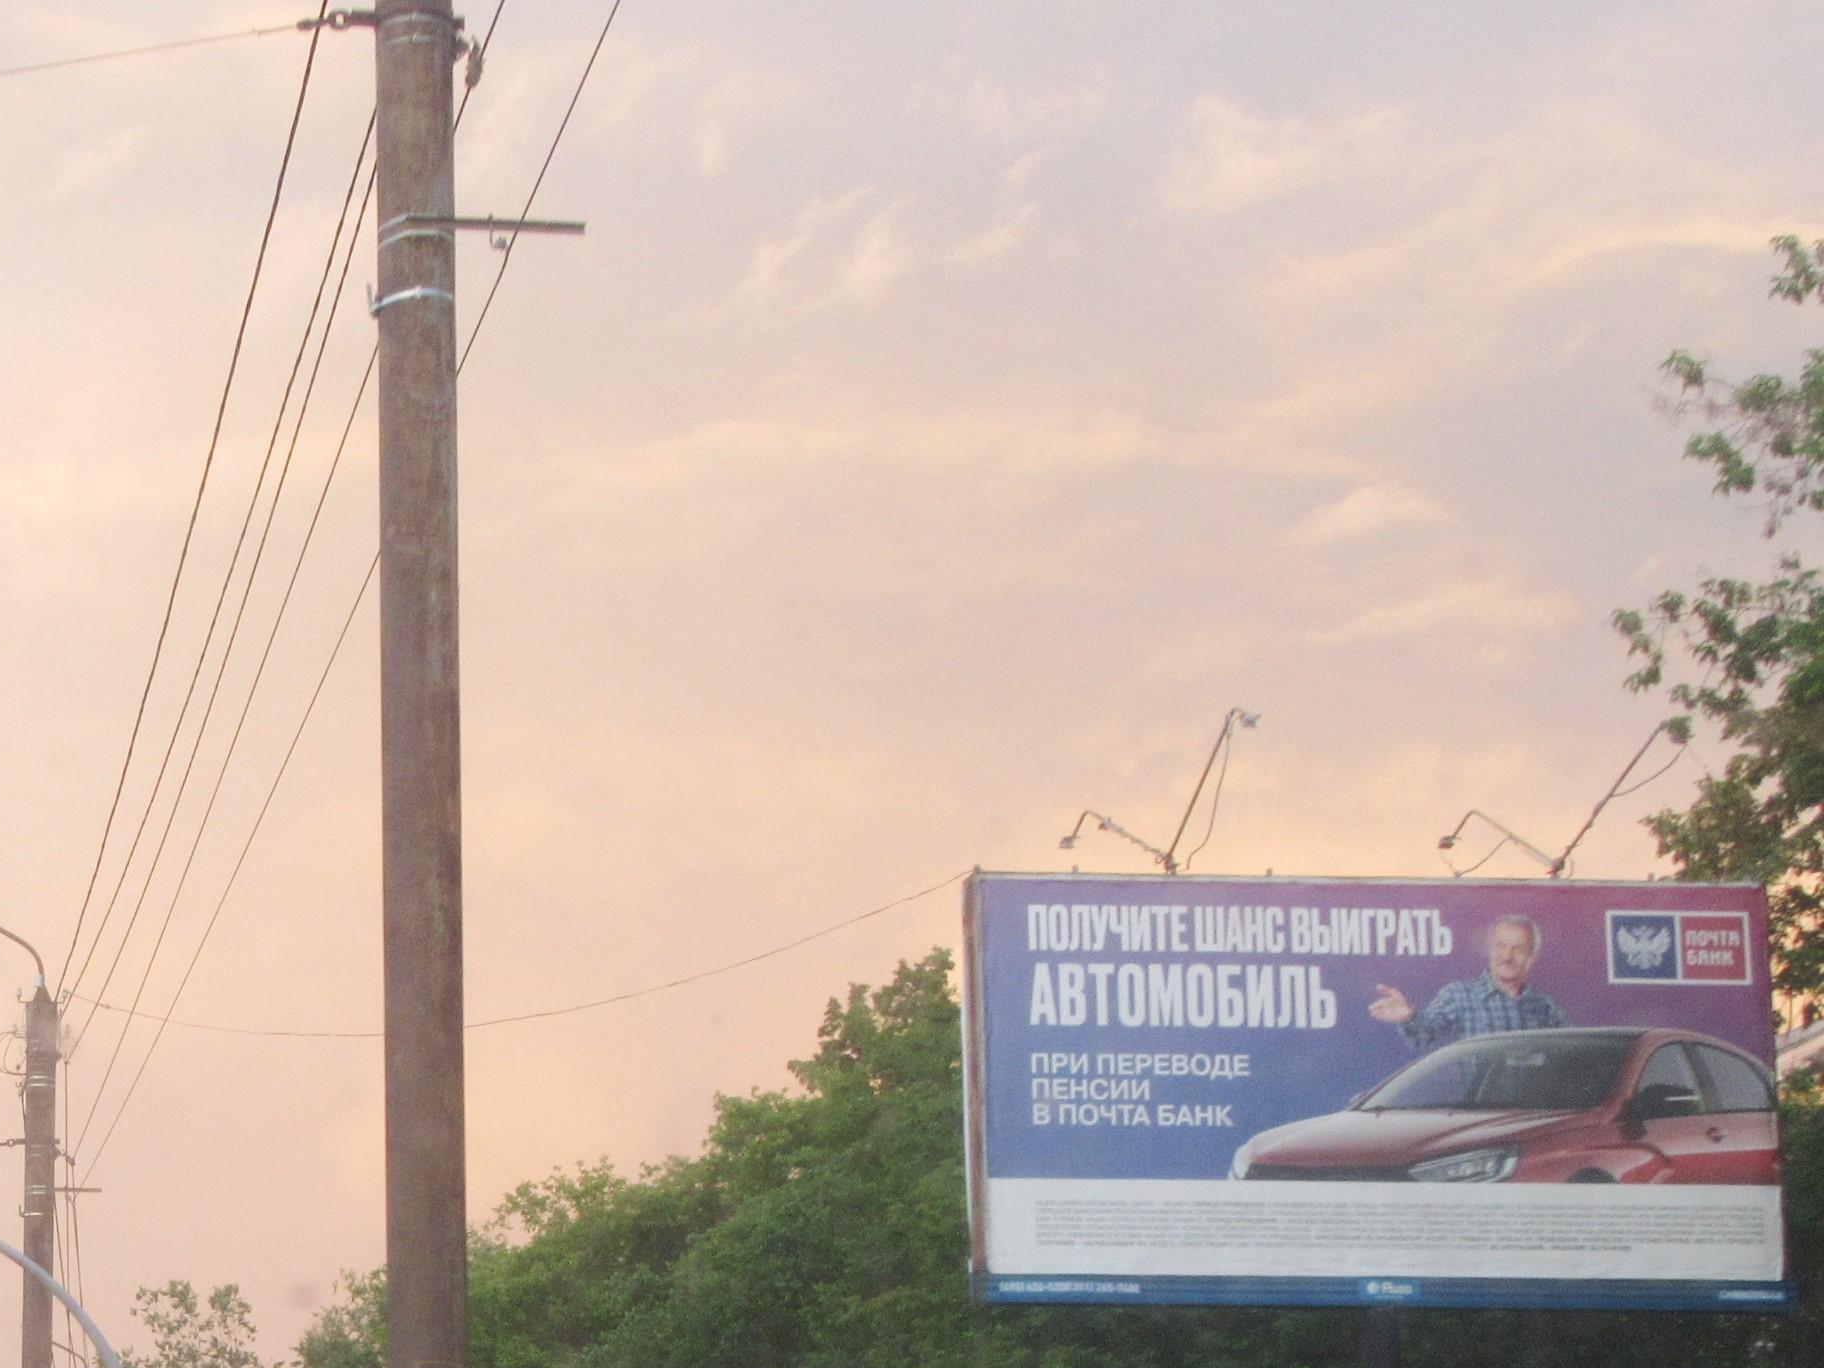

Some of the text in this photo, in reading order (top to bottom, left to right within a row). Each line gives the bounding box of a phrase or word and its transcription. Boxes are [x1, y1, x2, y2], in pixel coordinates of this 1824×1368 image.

[1027, 904, 1453, 956] ПОЛУЧИТЕ ШАНС ВЫИГРАТЬ
[1028, 962, 1337, 1029] АВТОМОБИЛЬ
[1030, 1053, 1251, 1079] ПРИ ПЕРЕВОДЕ
[1031, 1078, 1151, 1101] ПЕНСИИ
[1032, 1103, 1234, 1127] В ПОЧТА БАНК
